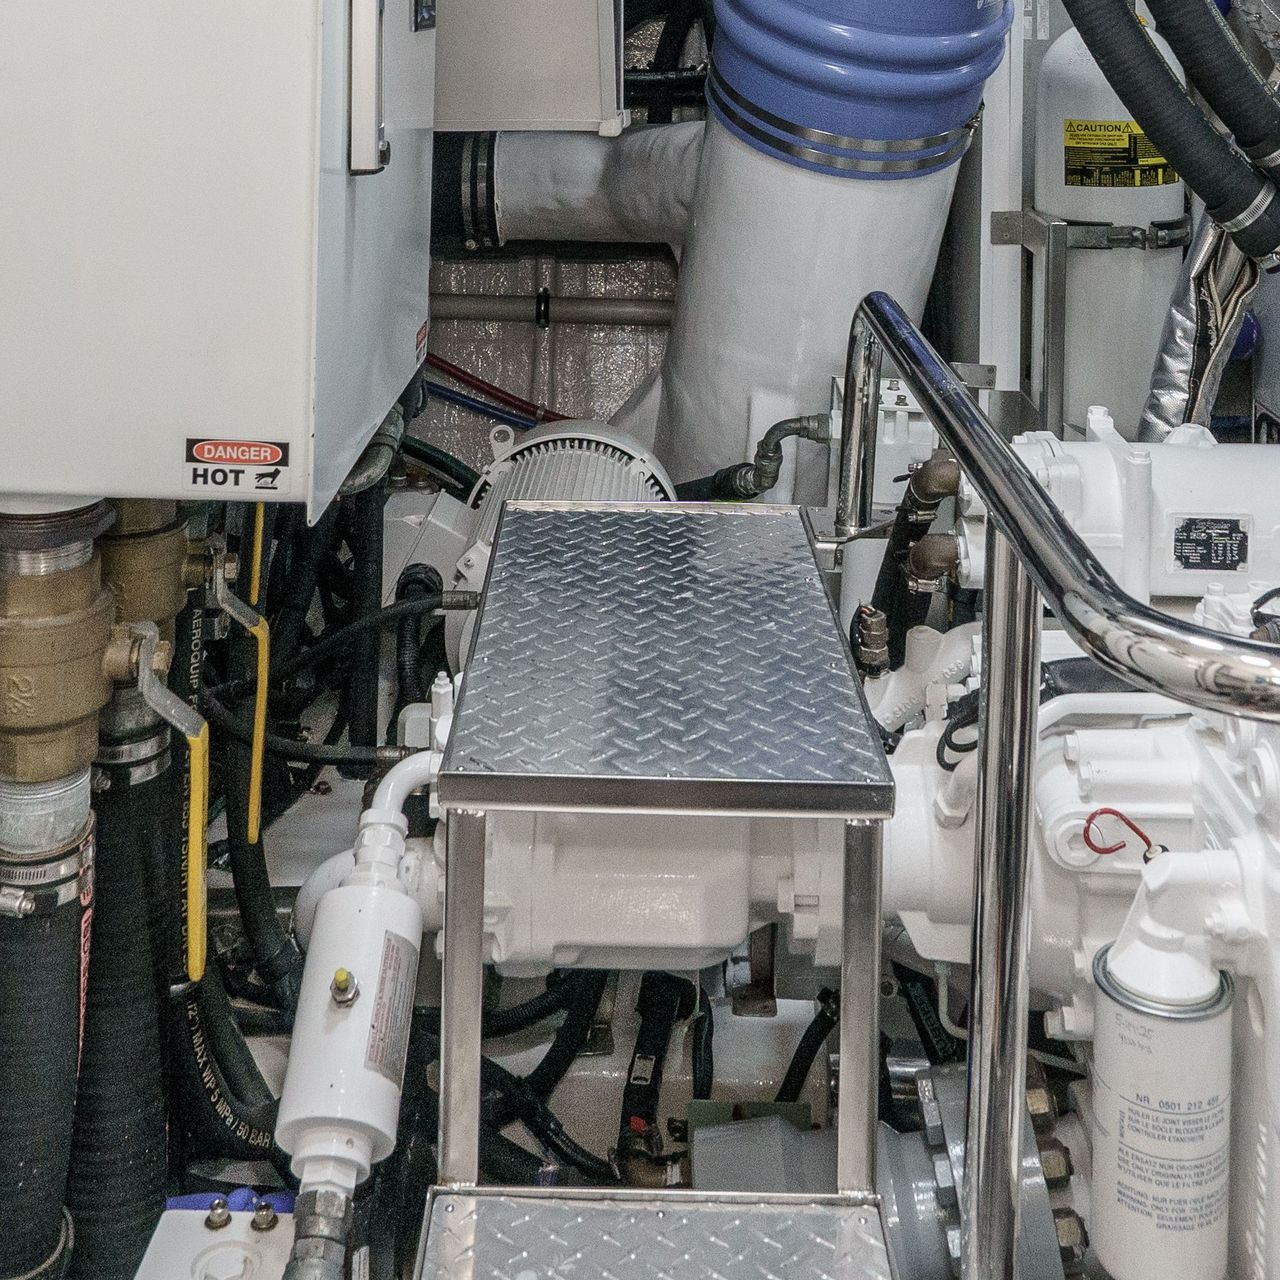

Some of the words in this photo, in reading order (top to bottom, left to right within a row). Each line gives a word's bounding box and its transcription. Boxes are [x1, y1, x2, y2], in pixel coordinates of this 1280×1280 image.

[1076, 124, 1121, 132] CAUTION
[203, 445, 271, 460] DANGER
[192, 468, 245, 486] HOT
[189, 609, 202, 688] AEROQUIP
[192, 1029, 208, 1069] MAX
[202, 1066, 217, 1089] WP
[210, 1089, 219, 1102] 5
[215, 1099, 234, 1126] MPa
[236, 1121, 250, 1140] 50
[248, 1129, 271, 1149] BAR
[1136, 1093, 1150, 1105] NR
[1158, 1100, 1180, 1111] 0501
[1187, 1101, 1203, 1110] 212
